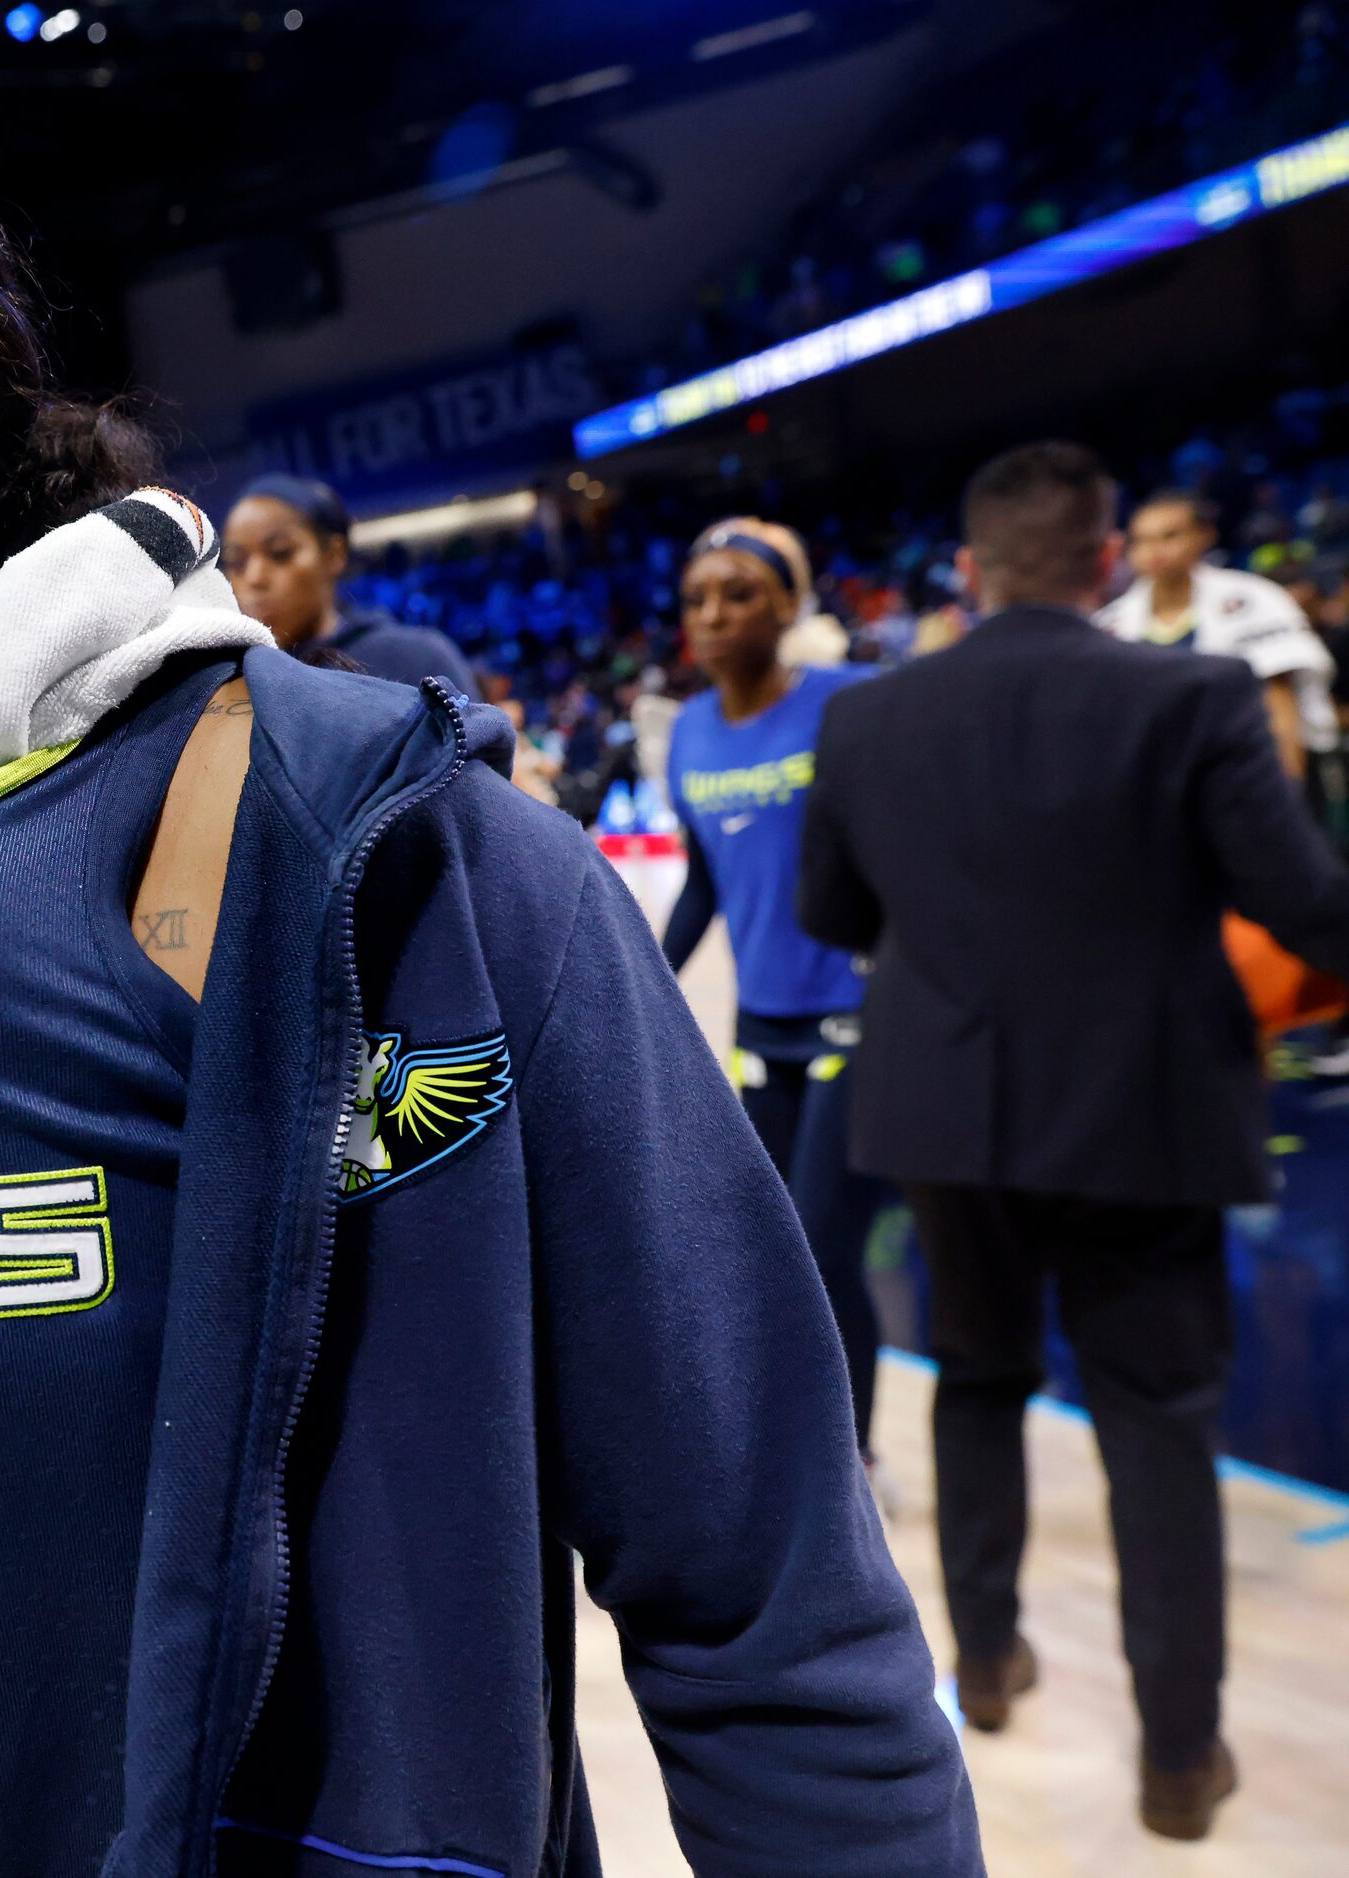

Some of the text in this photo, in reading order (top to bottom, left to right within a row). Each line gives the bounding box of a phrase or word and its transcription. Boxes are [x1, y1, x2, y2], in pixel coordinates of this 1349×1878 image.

[328, 392, 429, 482] FOR
[424, 343, 602, 450] TEXAS
[138, 908, 189, 950] XII
